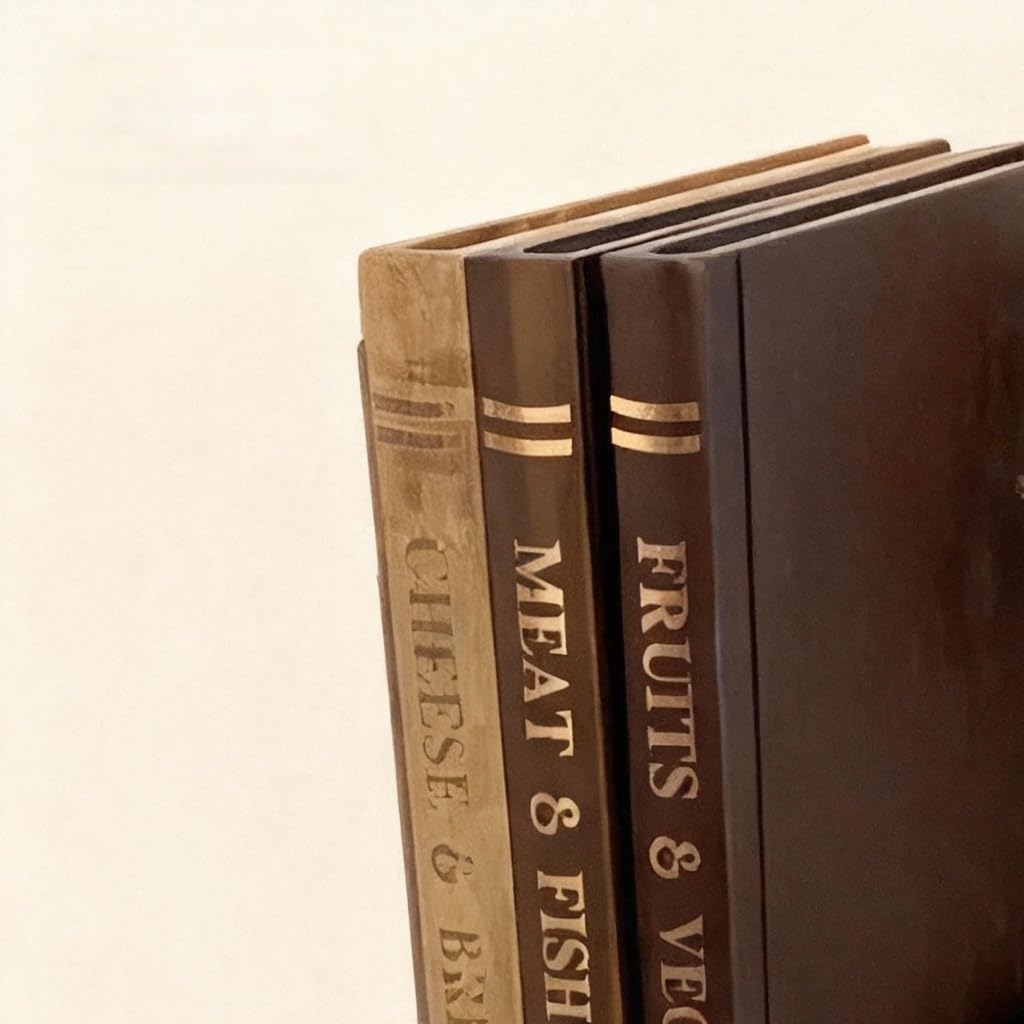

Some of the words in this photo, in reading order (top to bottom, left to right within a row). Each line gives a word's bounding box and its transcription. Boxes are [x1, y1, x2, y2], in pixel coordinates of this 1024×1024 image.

[514, 538, 574, 757] MEAT
[636, 537, 701, 799] FRUITS
[530, 792, 581, 835] &
[648, 836, 701, 879] &
[537, 870, 592, 1023] FISH
